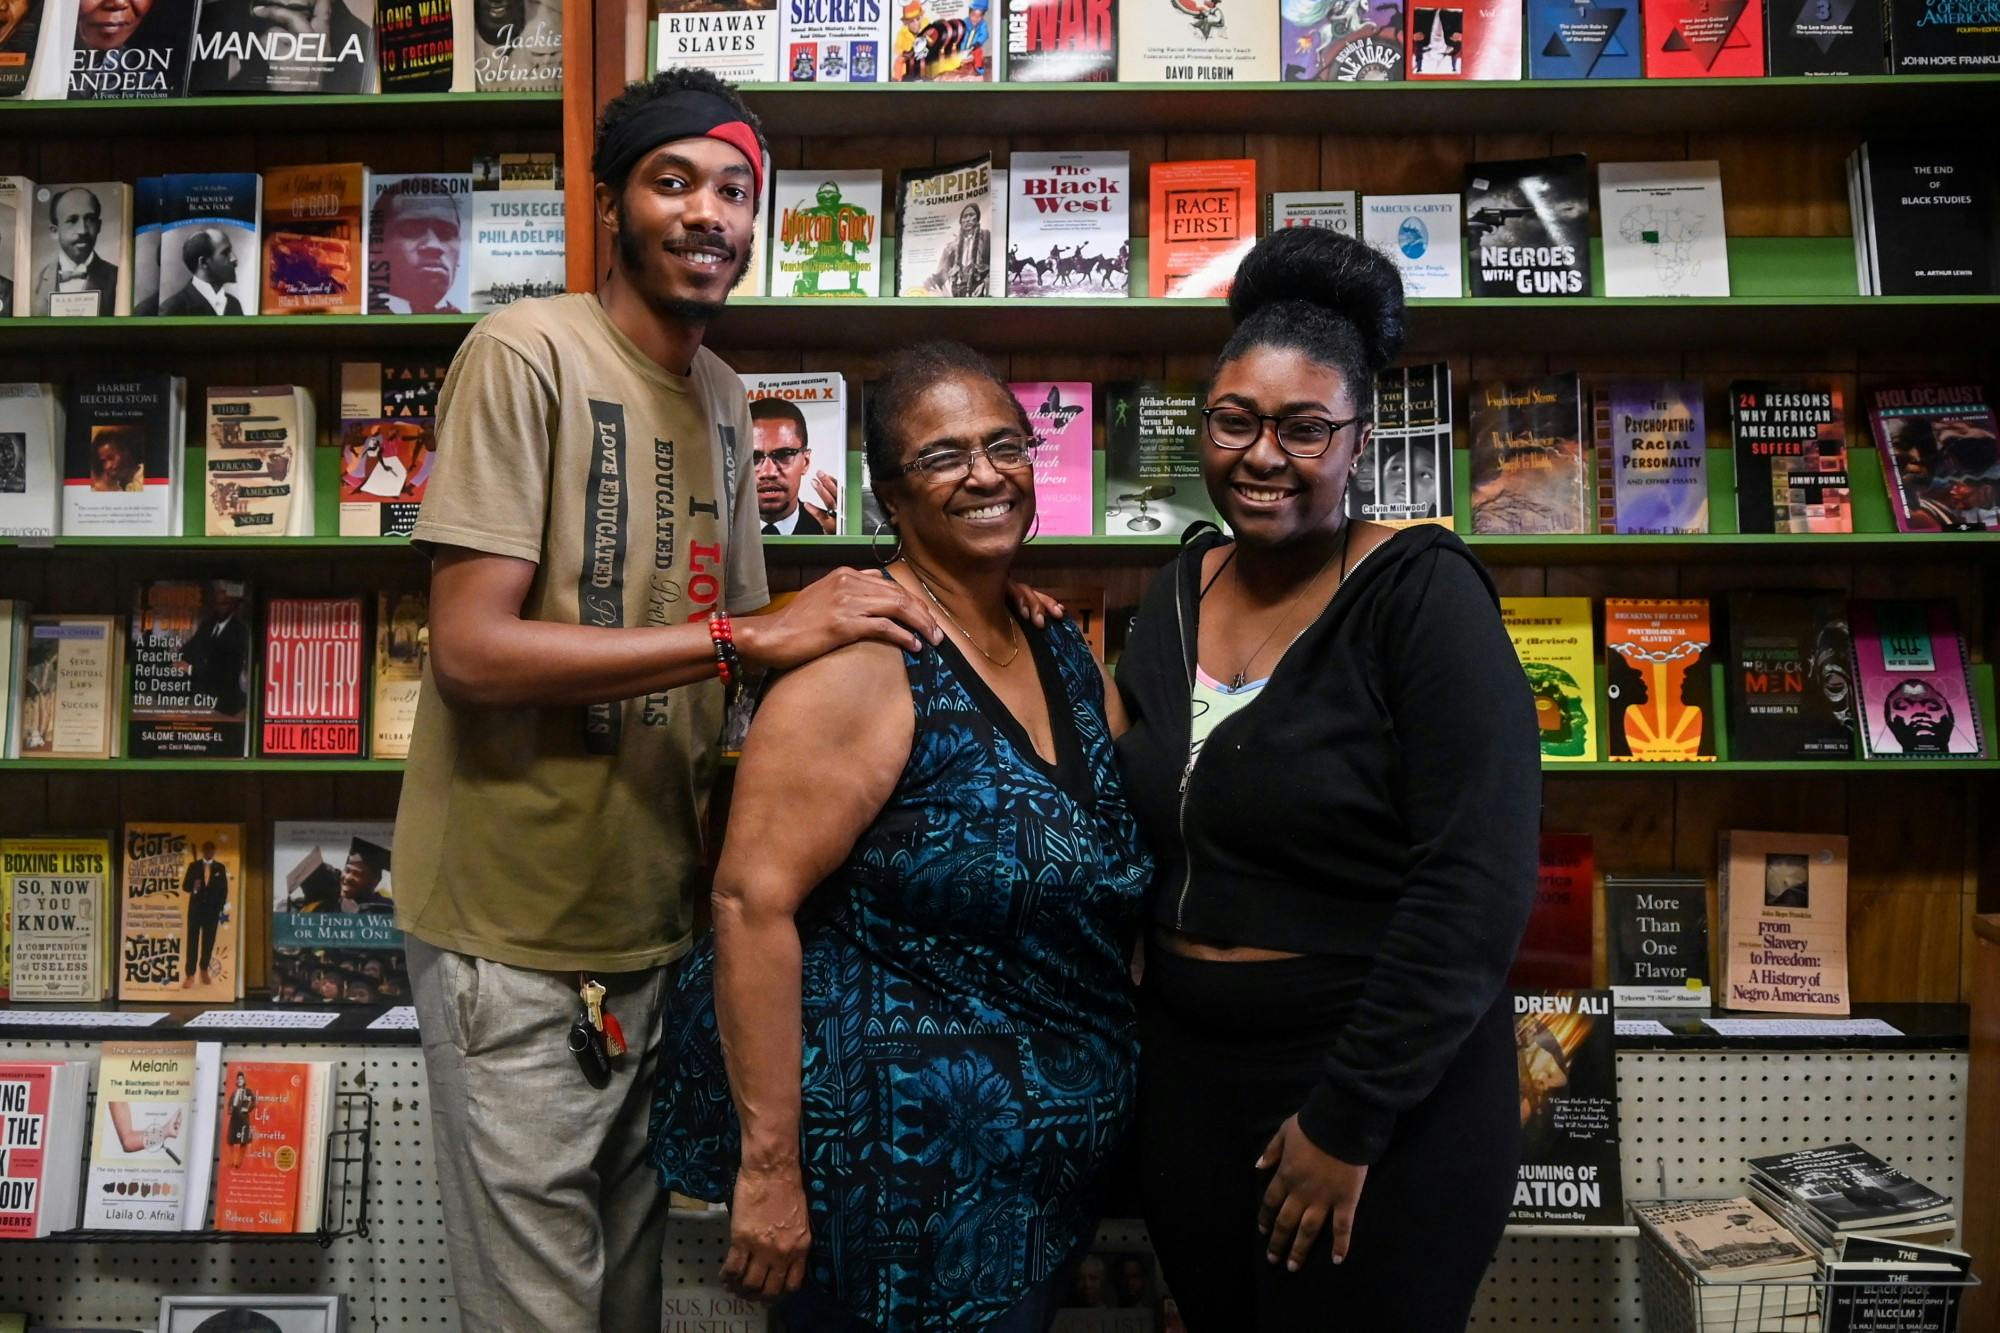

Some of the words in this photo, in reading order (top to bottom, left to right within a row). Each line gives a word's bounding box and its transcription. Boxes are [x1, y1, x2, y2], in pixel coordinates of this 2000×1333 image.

[380, 9, 414, 32] LONG
[419, 0, 451, 26] WALK
[791, 0, 880, 24] SECRETS
[670, 14, 767, 33] RUNAWAY
[1009, 11, 1027, 53] RACE
[192, 32, 364, 63] MANDELA
[493, 22, 562, 59] Jackie
[678, 35, 757, 53] SLAVES
[71, 48, 174, 72] ELSON
[383, 49, 396, 72] TO
[402, 38, 453, 69] FREEDOM
[1902, 56, 1928, 65] JOHN
[1930, 56, 1957, 65] HOPE
[1959, 55, 2000, 65] FRANKLI
[474, 55, 564, 85] Robinson
[1165, 66, 1193, 80] DAVID
[1197, 66, 1234, 80] PILGRIM
[67, 72, 168, 91] ANDELA
[1051, 165, 1091, 176] The
[1914, 166, 1931, 174] THE
[1934, 166, 1953, 174] END
[401, 178, 469, 194] ROBESON
[910, 166, 989, 198] EMPIRE
[1022, 177, 1120, 195] Black
[1929, 181, 1941, 189] OF
[926, 194, 965, 206] SUMMER
[966, 186, 989, 200] MOON
[1902, 196, 1932, 205] BLACK
[1934, 195, 1972, 205] STUDIES
[189, 203, 210, 211] BLACK
[212, 203, 231, 211] FOLK
[310, 194, 340, 217] GOLD
[1031, 195, 1112, 214] West
[1175, 197, 1229, 215] RACE
[1371, 204, 1411, 213] MARCUS
[1413, 204, 1453, 213] GARVEY
[1287, 209, 1316, 217] MARCUS
[781, 207, 832, 245] African
[837, 207, 875, 246] Glory
[1174, 216, 1232, 234] FIRST
[479, 229, 565, 244] PHILADELPH
[1481, 247, 1576, 267] NEGROES
[1482, 269, 1514, 282] WITH
[1516, 269, 1583, 294] GUNS
[97, 384, 141, 392] HARRIET
[758, 381, 767, 389] By
[801, 377, 829, 385] necessary
[80, 395, 124, 404] BEECHER
[125, 395, 158, 403] STOWE
[746, 388, 817, 401] MALCOLM
[823, 388, 833, 399] X
[1139, 397, 1196, 407] Afrikan-Centered
[1740, 394, 1756, 408] 24
[1765, 394, 1831, 407] REASONS
[1139, 407, 1187, 417] Consciousness
[1650, 400, 1668, 411] THE
[1139, 417, 1161, 427] Versus
[1162, 417, 1174, 426] the
[1740, 410, 1768, 422] WHY
[1774, 410, 1831, 422] AFRICAN
[1139, 427, 1153, 436] New
[1155, 426, 1175, 436] World
[1177, 426, 1197, 436] Order
[1624, 415, 1696, 434] PSYCHOPATHIC
[1740, 426, 1817, 438] AMERICANS
[600, 421, 618, 476] LOVE
[1632, 438, 1692, 450] RACIAL
[1752, 443, 1801, 455] SUFFER
[1621, 455, 1701, 469] PERSONALITY
[1789, 476, 1815, 485] JIMMY
[1818, 476, 1846, 484] DUMAS
[654, 437, 674, 571] EDUCATED
[1362, 503, 1388, 513] Calvin
[1389, 503, 1426, 513] Millwood
[591, 479, 620, 589] EDUCATED
[270, 602, 359, 639] VOLUNTEER
[1615, 612, 1651, 620] BREAKING
[1627, 628, 1686, 636] PSYCHOLOGICAL
[136, 637, 145, 647] A
[149, 636, 182, 647] Black
[136, 650, 184, 662] Teacher
[135, 664, 185, 677] Refuses
[135, 680, 146, 691] to
[150, 680, 191, 691] Desert
[267, 641, 359, 717] SLAVERY
[1745, 671, 1804, 693] MEN
[134, 694, 152, 706] the
[157, 694, 189, 706] Inner
[193, 694, 218, 708] City
[141, 731, 174, 741] SALOME
[177, 732, 223, 741] THOMAS-EL
[266, 727, 296, 750] JILL
[300, 727, 356, 750] NELSON
[4, 854, 58, 873] BOXING
[62, 854, 103, 873] LISTS
[18, 880, 45, 896] SO,
[51, 880, 90, 895] NOW
[37, 898, 71, 910] YOU
[1636, 894, 1680, 910] More
[17, 915, 89, 931] KNOW...
[290, 914, 314, 926] I'LL
[320, 914, 352, 926] FIND
[356, 916, 364, 926] A
[367, 914, 394, 926] WAY
[1636, 916, 1681, 932] Than
[294, 930, 312, 939] OR
[317, 927, 354, 939] MAKE
[361, 928, 391, 939] ONE
[1758, 921, 1791, 936] From
[25, 943, 87, 951] COMPENDIUM
[125, 936, 181, 962] JALEN
[1641, 939, 1678, 955] One
[1763, 934, 1808, 953] Slavery
[1750, 952, 1762, 965] to
[1763, 951, 1821, 967] Freedom:
[32, 963, 88, 971] USELESS
[125, 955, 180, 984] ROSE
[1634, 962, 1688, 978] Flavor
[16, 973, 87, 981] INFORMATION
[1749, 970, 1759, 984] A
[1762, 970, 1807, 986] History
[1808, 972, 1821, 986] of
[1733, 984, 1770, 1002] Negro
[1771, 986, 1841, 1004] Americans
[1514, 996, 1573, 1014] DREW
[1577, 997, 1608, 1015] ALI
[130, 1059, 178, 1072] Melanin
[254, 1107, 270, 1121] Life
[8, 1117, 40, 1146] THE
[1517, 1165, 1575, 1180] HUMING
[1577, 1165, 1598, 1181] OF
[1512, 1181, 1601, 1208] ATION
[105, 1208, 133, 1220] Llaila
[136, 1210, 147, 1220] O.
[150, 1210, 175, 1221] Afrika
[224, 1209, 254, 1224] Rebecca
[1898, 1249, 1918, 1261] THE
